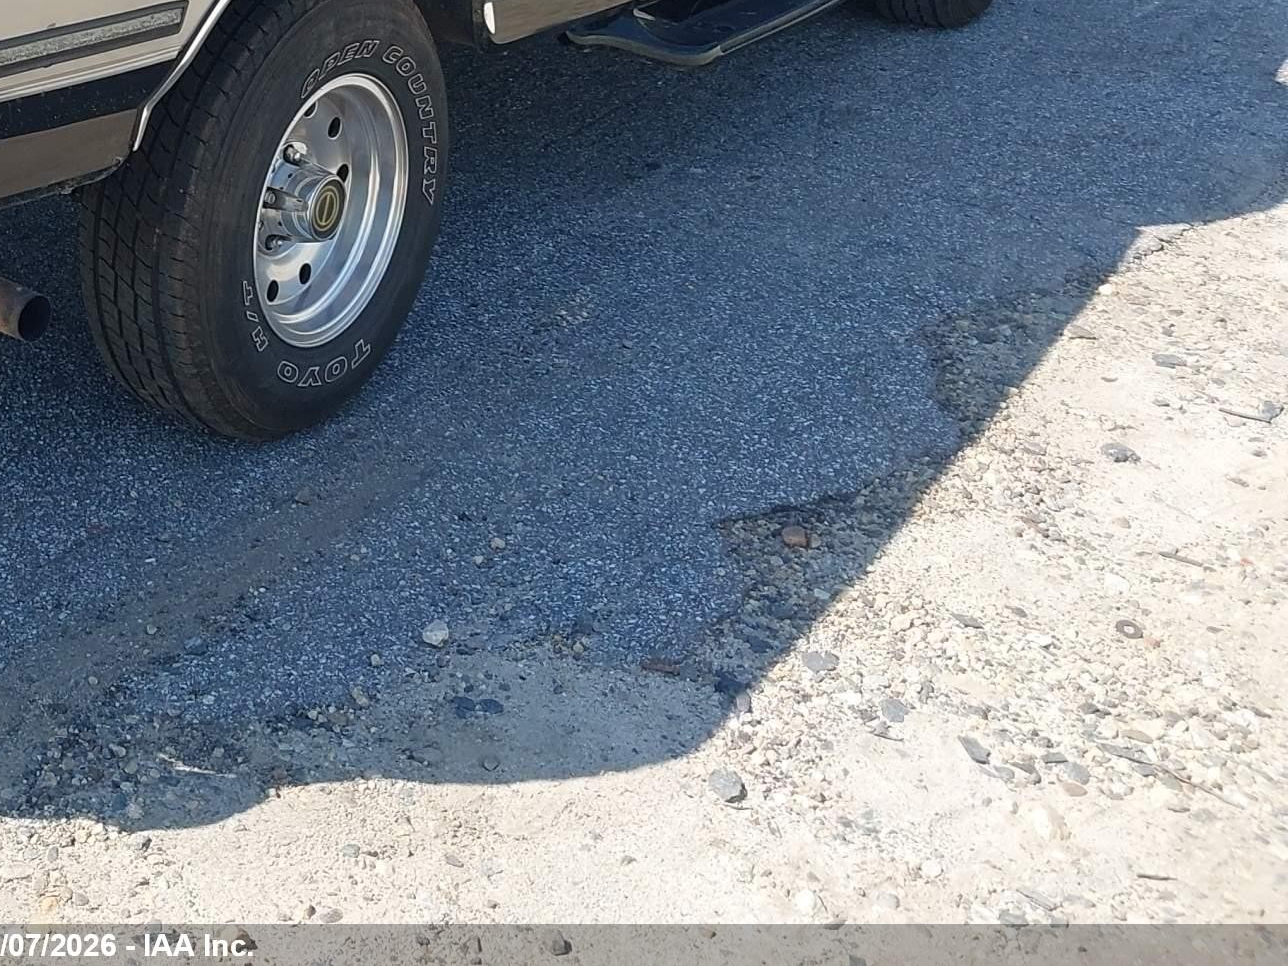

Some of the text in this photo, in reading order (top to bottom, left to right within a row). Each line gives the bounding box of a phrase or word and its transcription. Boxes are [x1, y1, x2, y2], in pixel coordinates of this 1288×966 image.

[300, 40, 438, 205] OPEN COUNTRY
[277, 339, 371, 387] TOYO
